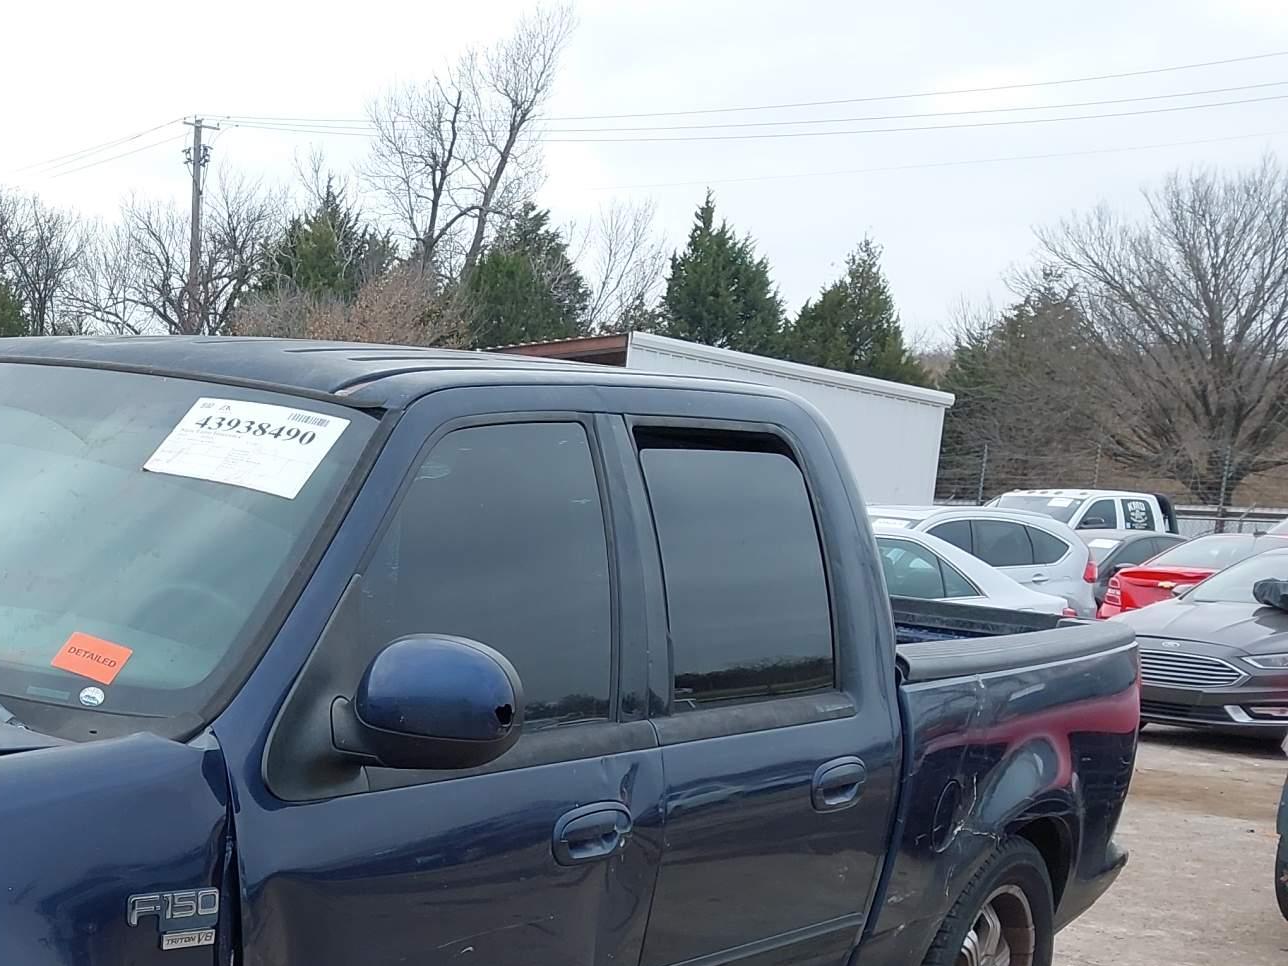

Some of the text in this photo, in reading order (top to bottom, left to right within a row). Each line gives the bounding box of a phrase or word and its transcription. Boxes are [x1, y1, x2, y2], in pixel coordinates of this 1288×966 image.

[195, 415, 316, 446] 43938490
[68, 646, 117, 668] DETAILED
[166, 932, 213, 946] TRITON V8
